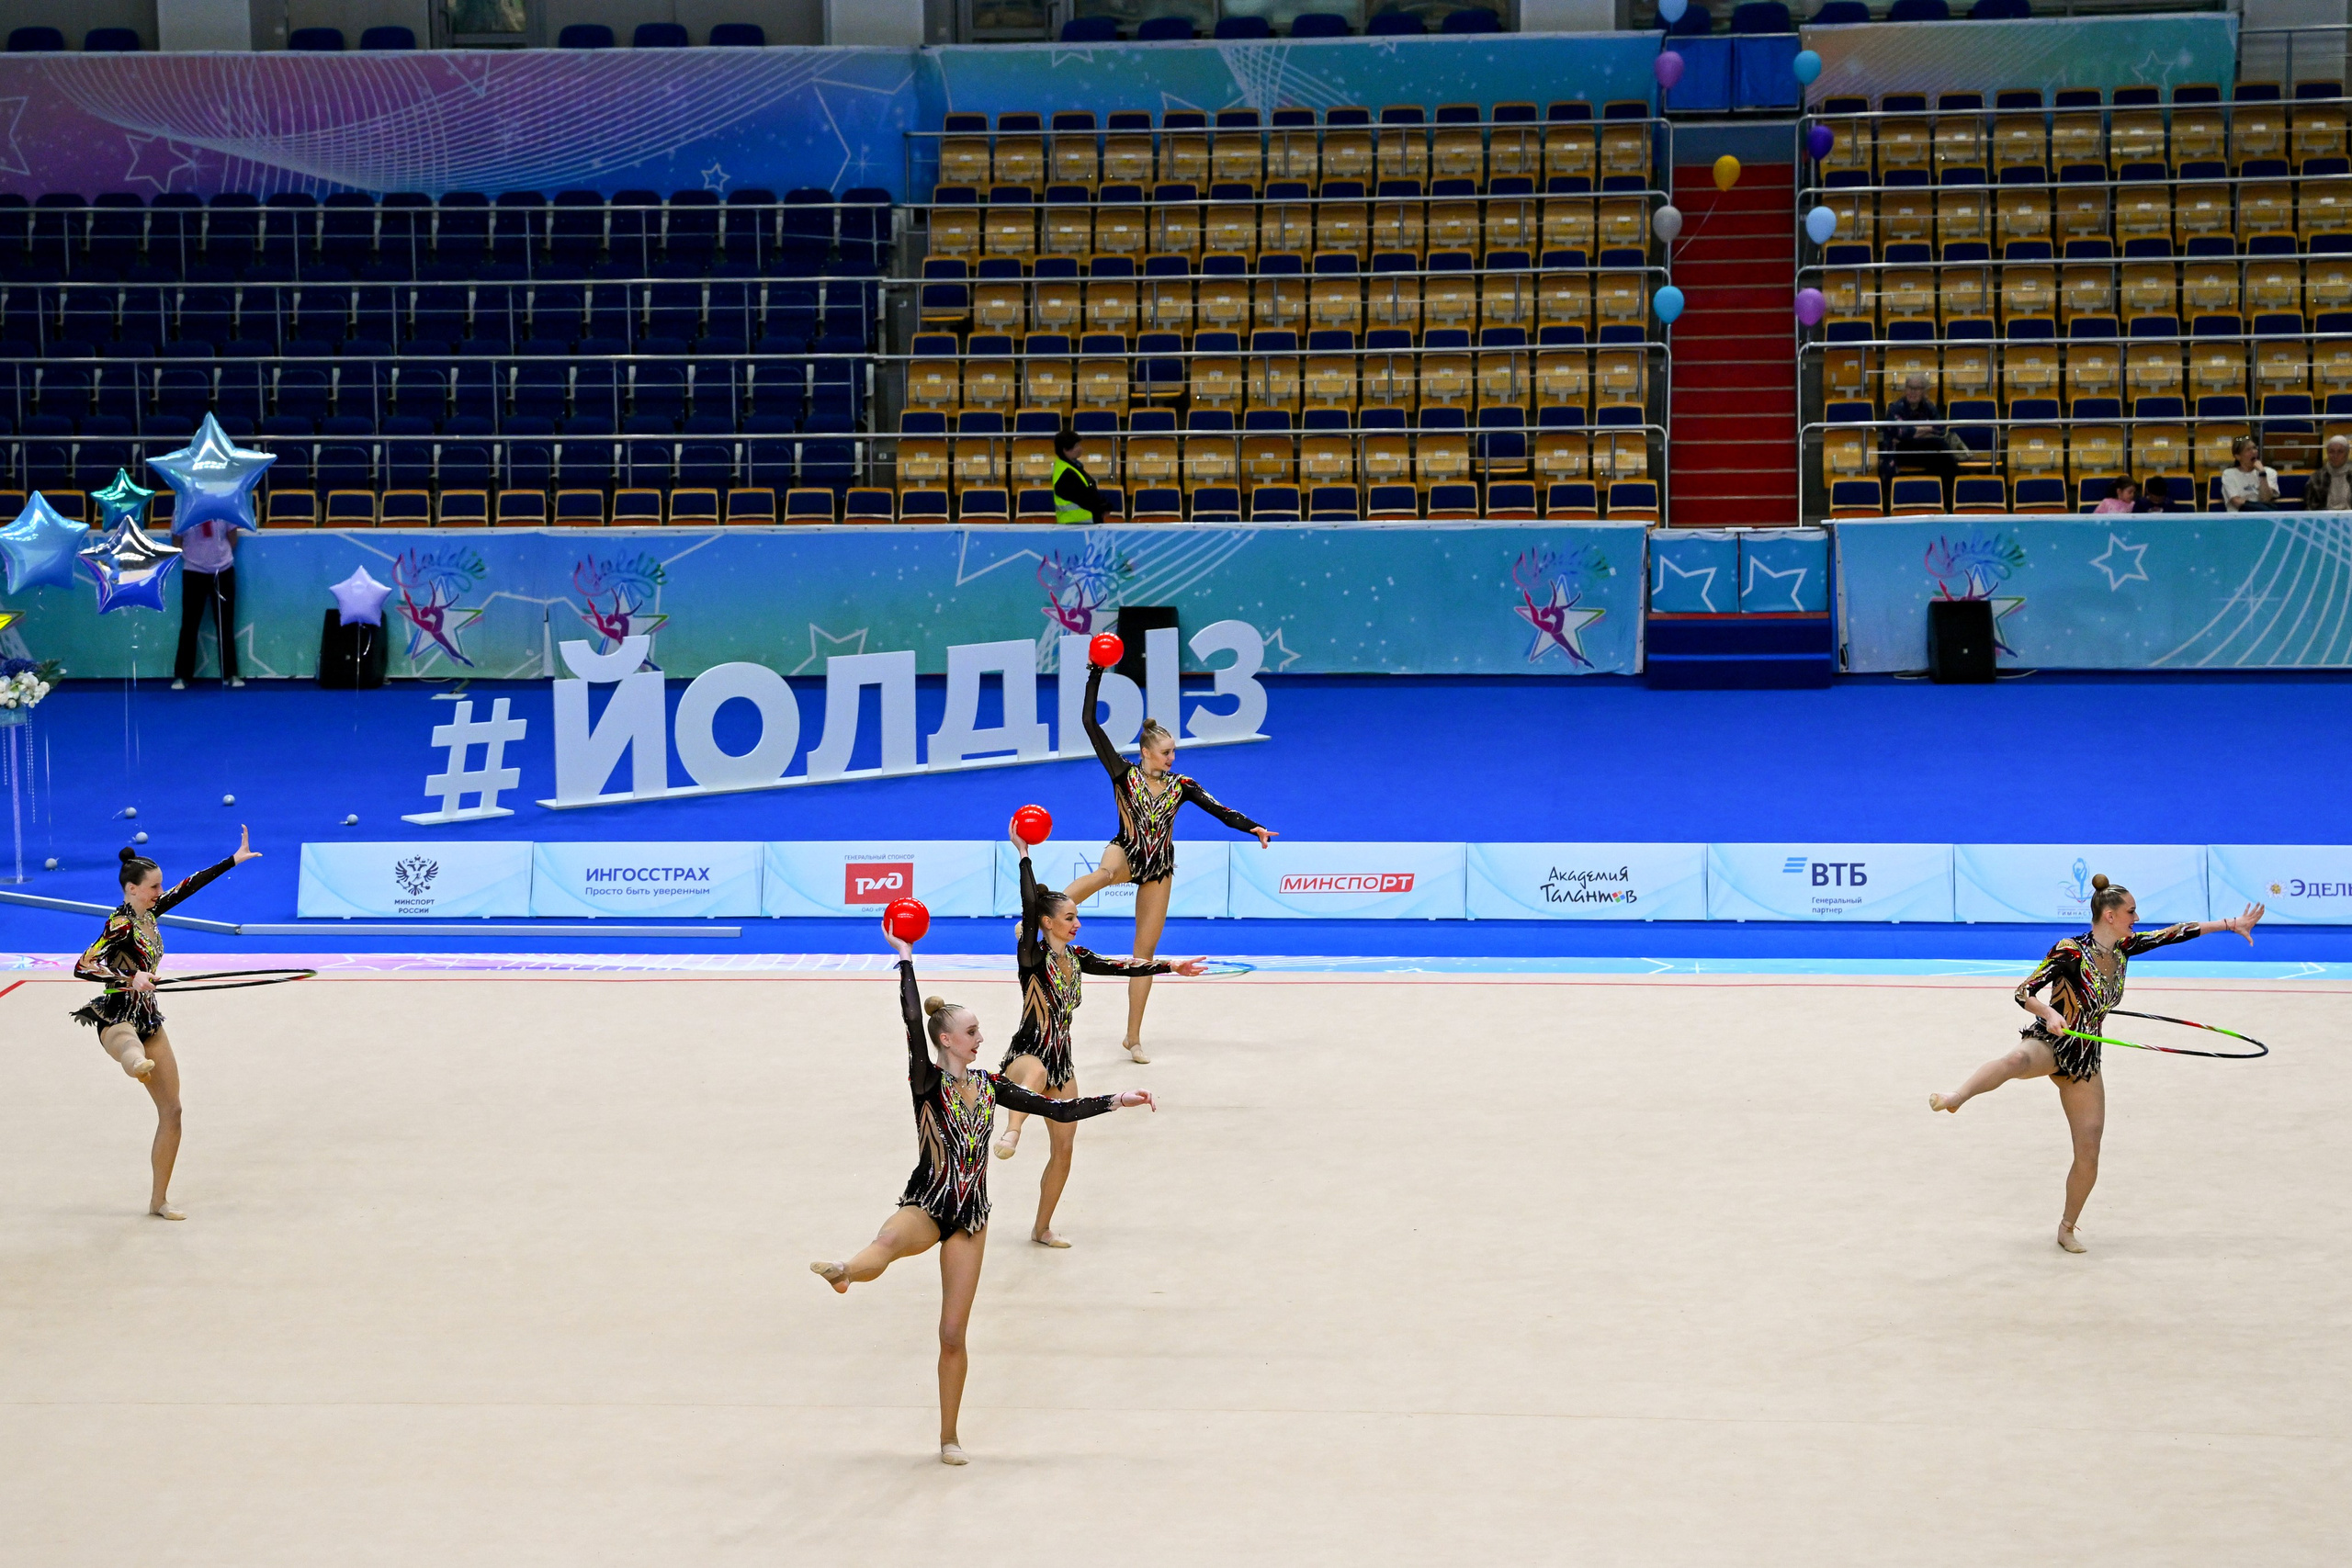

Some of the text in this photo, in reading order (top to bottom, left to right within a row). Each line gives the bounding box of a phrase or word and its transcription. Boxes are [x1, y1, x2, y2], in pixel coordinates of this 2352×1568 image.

[586, 867, 710, 882] ИНГОССТРАХ
[1812, 863, 1868, 886] ВТБ
[1283, 876, 1412, 890] МИНСПОРТ
[585, 886, 710, 897] Просто быть уверенным
[1812, 897, 1862, 905] Генеральный
